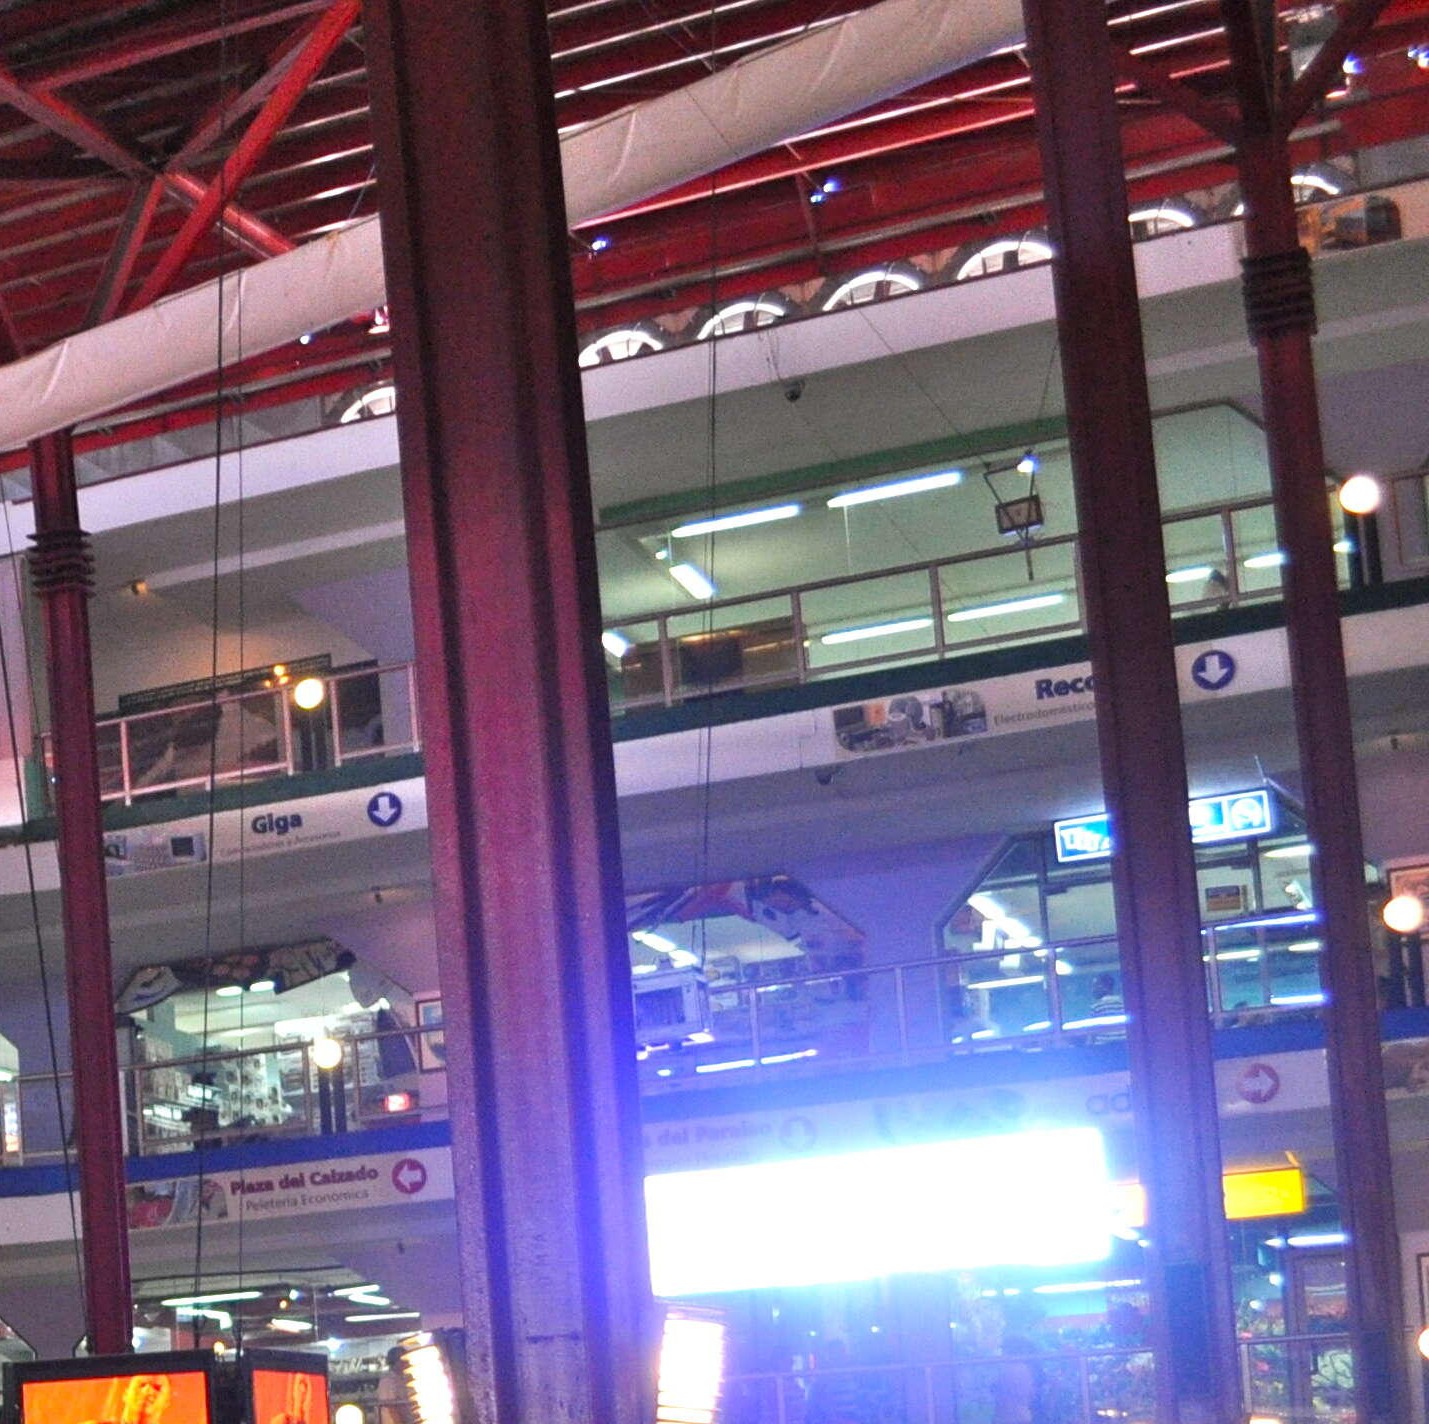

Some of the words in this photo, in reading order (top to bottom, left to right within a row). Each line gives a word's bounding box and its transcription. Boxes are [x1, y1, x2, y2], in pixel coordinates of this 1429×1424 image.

[1035, 675, 1094, 700] Reco
[251, 813, 303, 835] Giga
[231, 1177, 274, 1195] Plaza
[278, 1172, 305, 1190] del
[309, 1164, 379, 1186] Calzado
